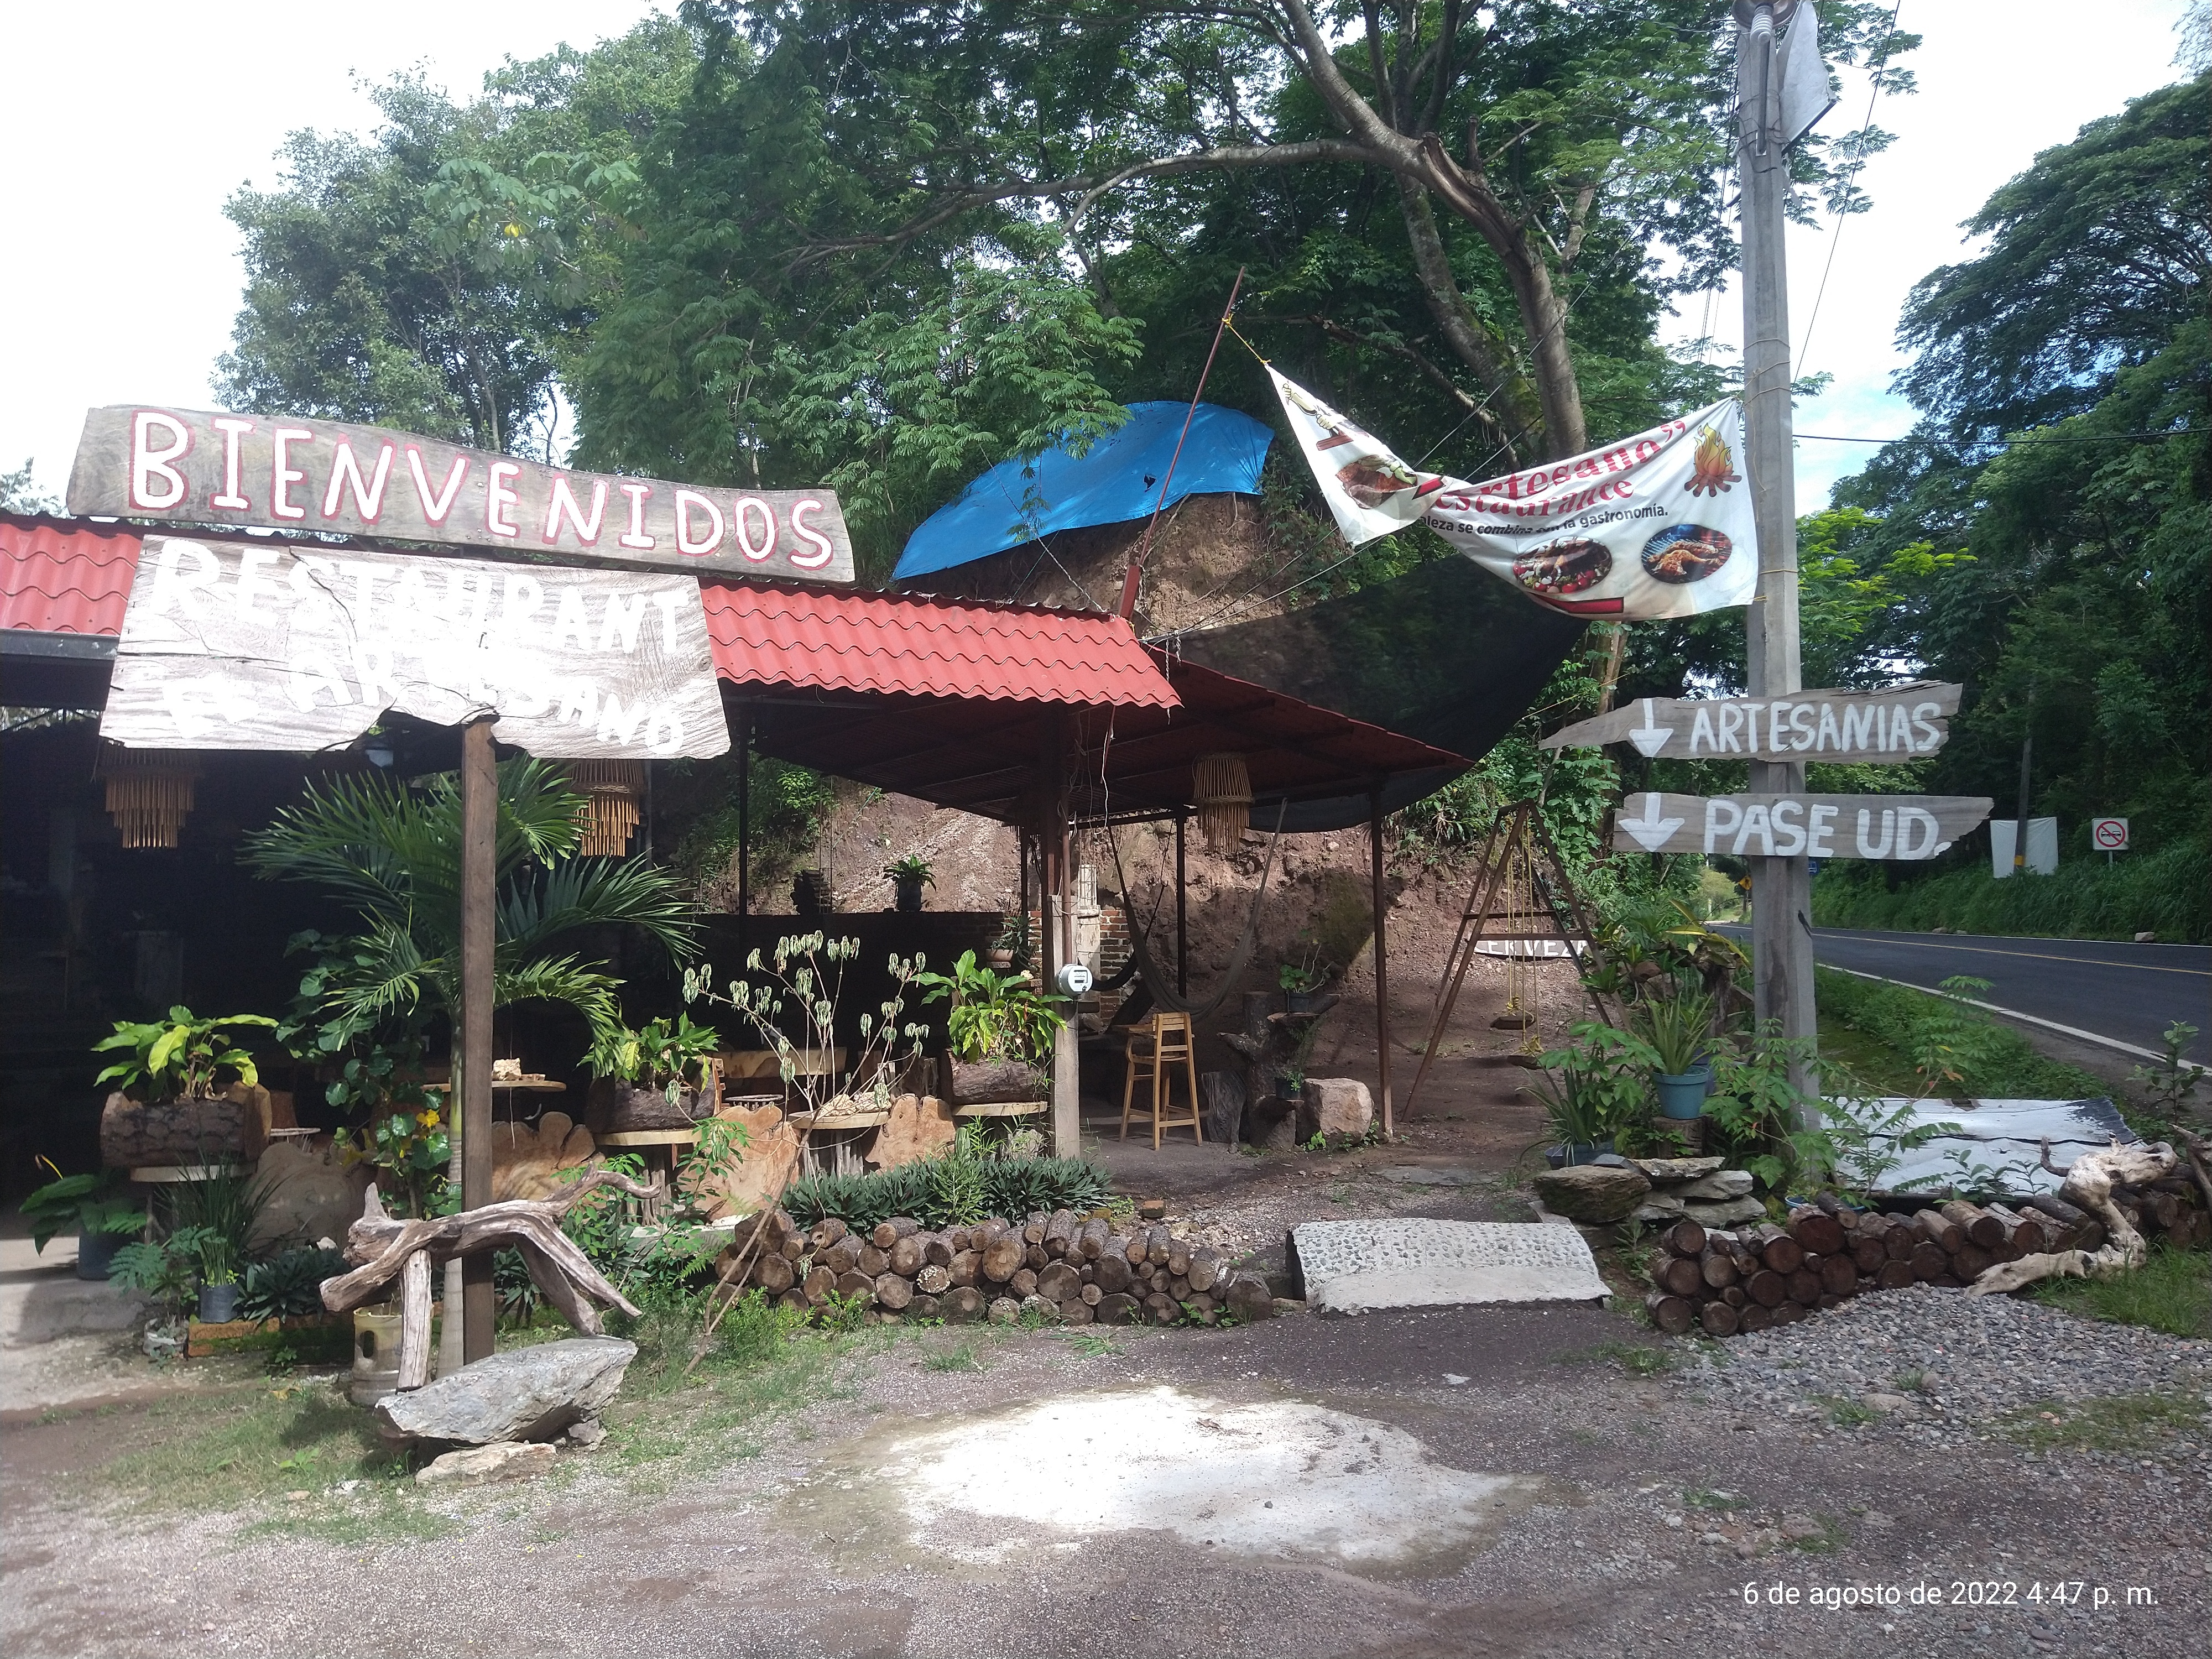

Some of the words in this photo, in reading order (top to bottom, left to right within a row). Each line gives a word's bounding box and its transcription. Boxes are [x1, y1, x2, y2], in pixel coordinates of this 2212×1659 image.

[130, 410, 834, 569] BIENVENIDOS
[1458, 523, 1474, 534] se
[1579, 503, 1668, 528] gastronomía.
[149, 539, 689, 654] RESTAURANT
[1689, 701, 1941, 753] ARTESANIAS
[1704, 799, 1839, 858] PASE
